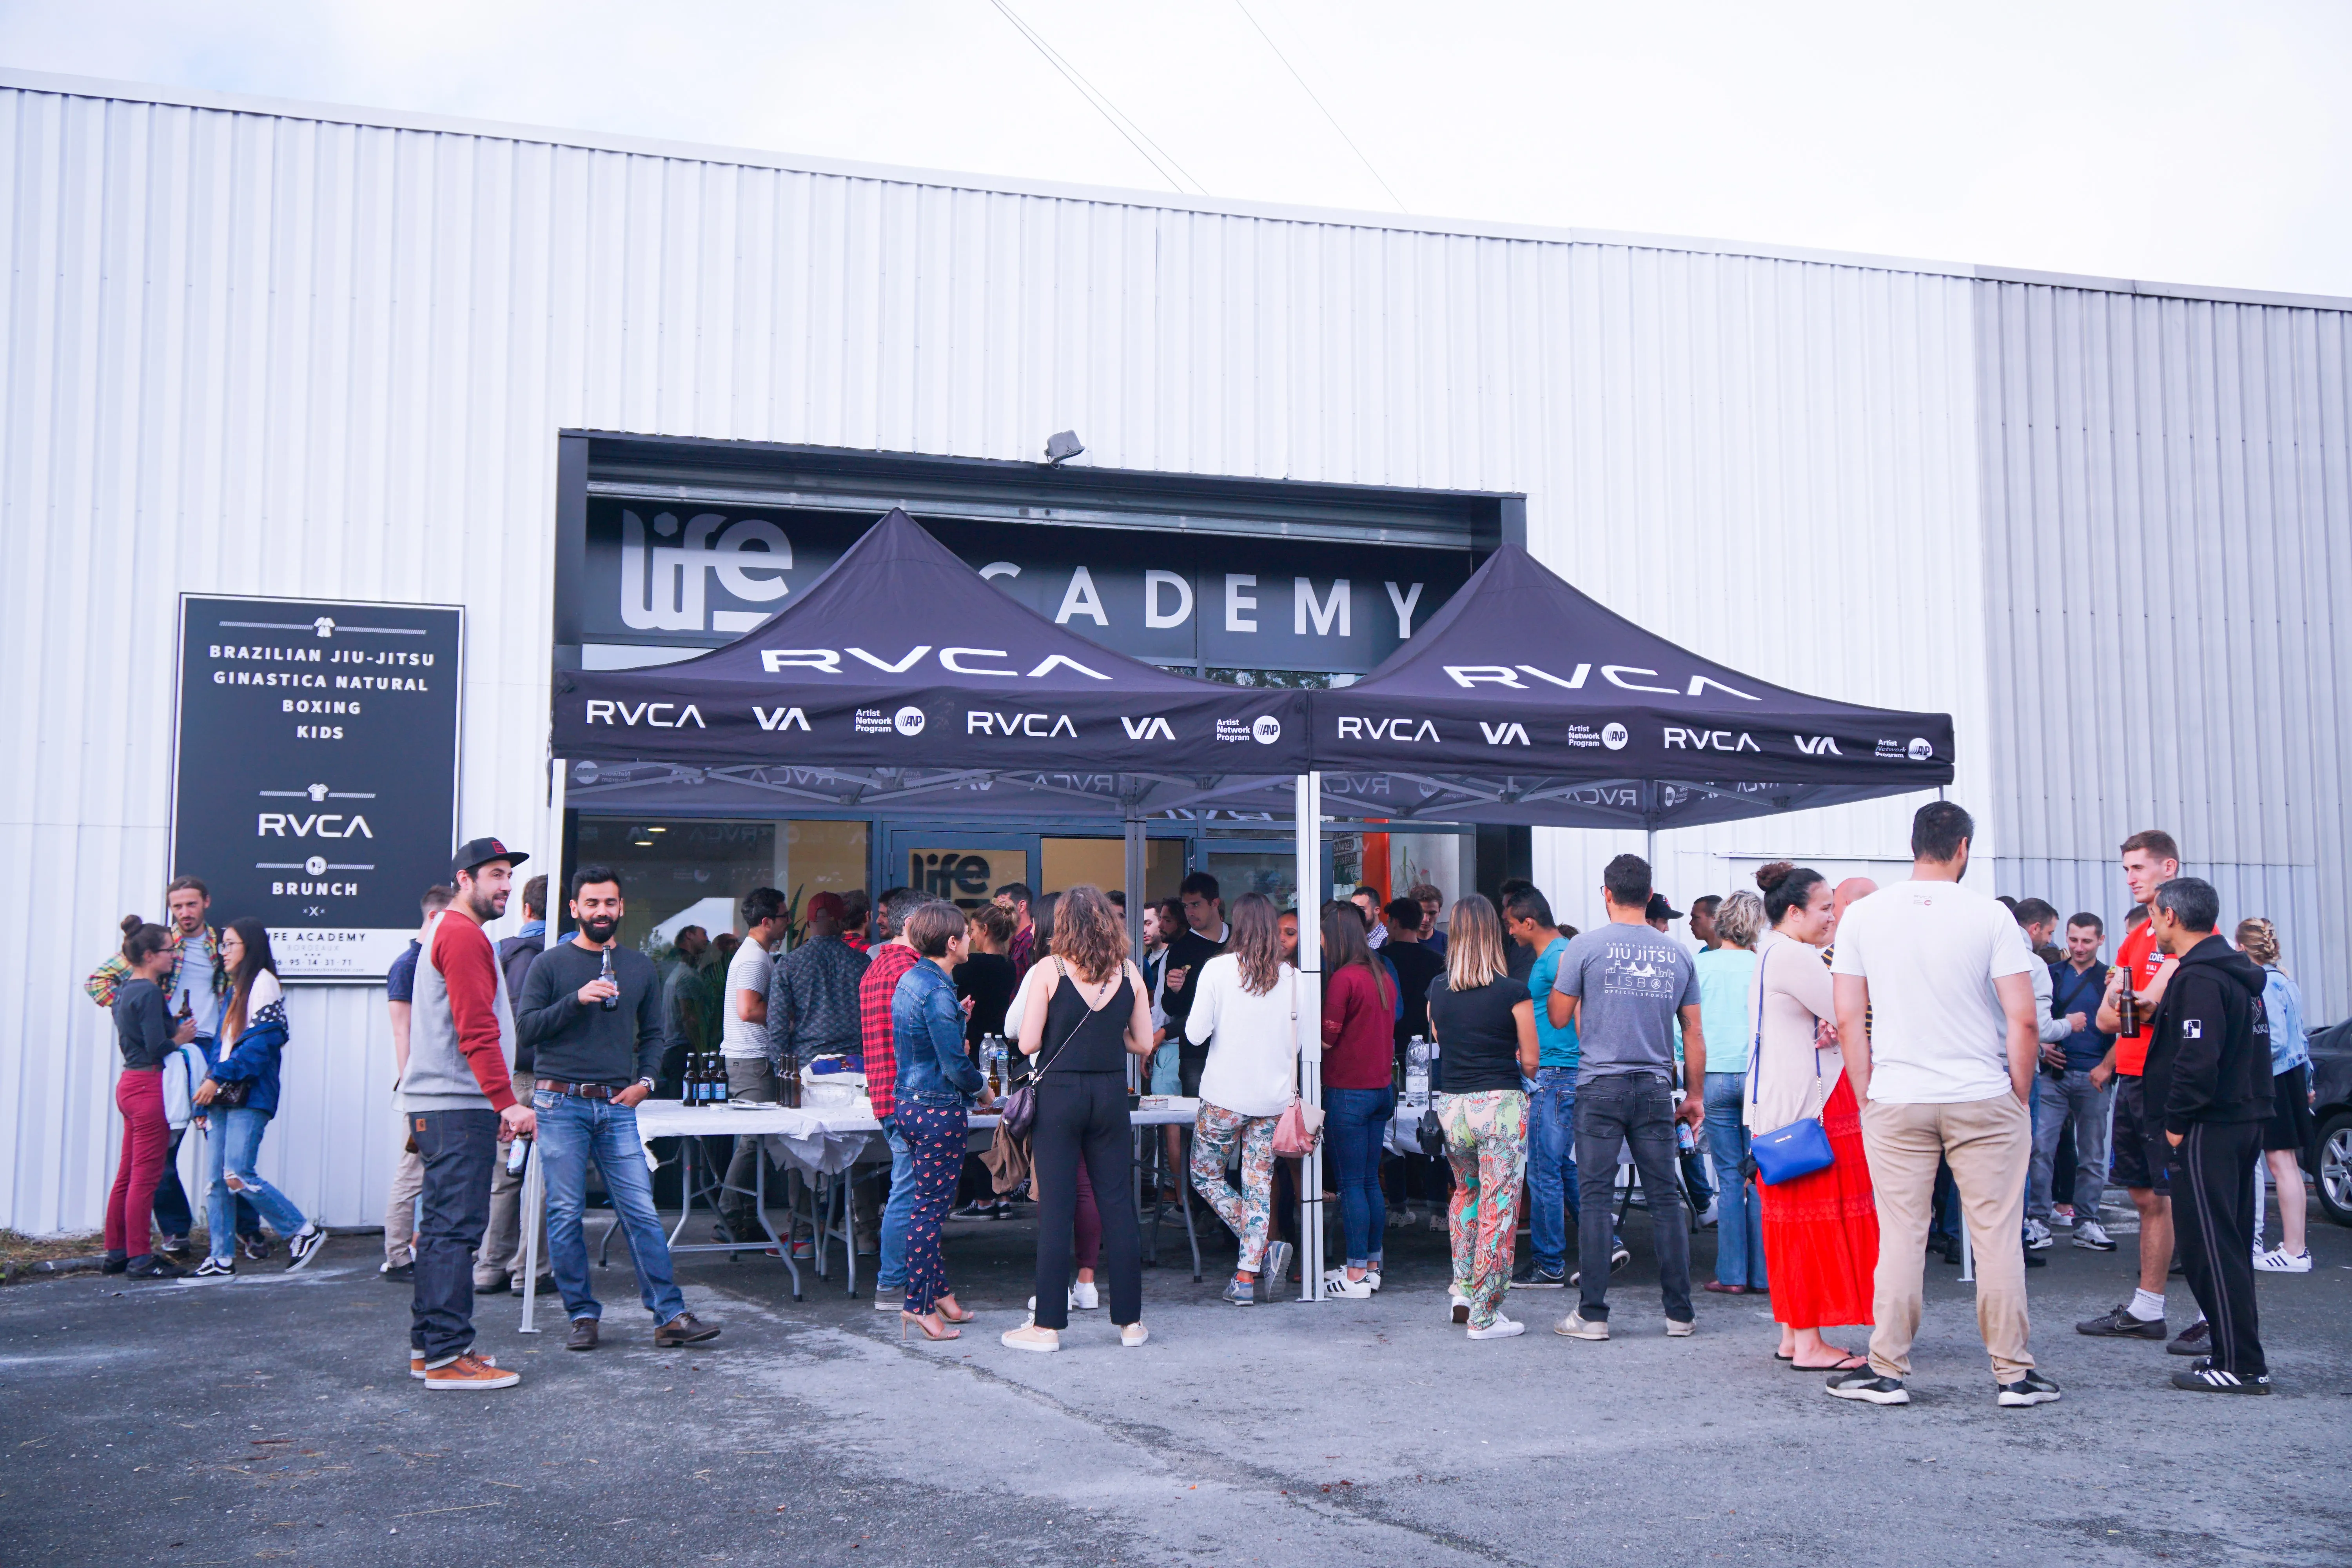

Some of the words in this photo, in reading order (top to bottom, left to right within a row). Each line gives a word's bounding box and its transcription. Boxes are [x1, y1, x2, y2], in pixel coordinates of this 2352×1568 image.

[621, 509, 793, 631] life
[210, 645, 321, 662] BRAZILIAN
[330, 650, 434, 666] JIU-JITSU
[761, 646, 1113, 680] RVCA
[213, 671, 327, 687] GINASTICA
[336, 676, 428, 691] NATURAL
[1443, 663, 1762, 700] RVCA
[282, 699, 361, 714] BOXING
[586, 700, 706, 728] RVCA
[752, 706, 811, 731] VA
[855, 717, 892, 725] Network
[855, 724, 891, 733] Program
[967, 711, 1078, 738] RVCA
[1120, 717, 1176, 740] VA
[297, 726, 344, 739] KIDS
[1216, 733, 1250, 742] Program
[1338, 717, 1441, 742] RVCA
[1479, 722, 1531, 745] VA
[1664, 727, 1761, 752] RVCA
[1568, 739, 1600, 748] Program
[1794, 735, 1843, 755] VA
[258, 813, 373, 838] RVCA
[272, 882, 358, 896] BRUNCH
[296, 933, 365, 942] ACADEMY
[1606, 942, 1676, 951] CHAMPIONSHIP
[1606, 947, 1630, 959] JIU
[1635, 950, 1676, 963] JITSU
[2149, 953, 2165, 962] CORE
